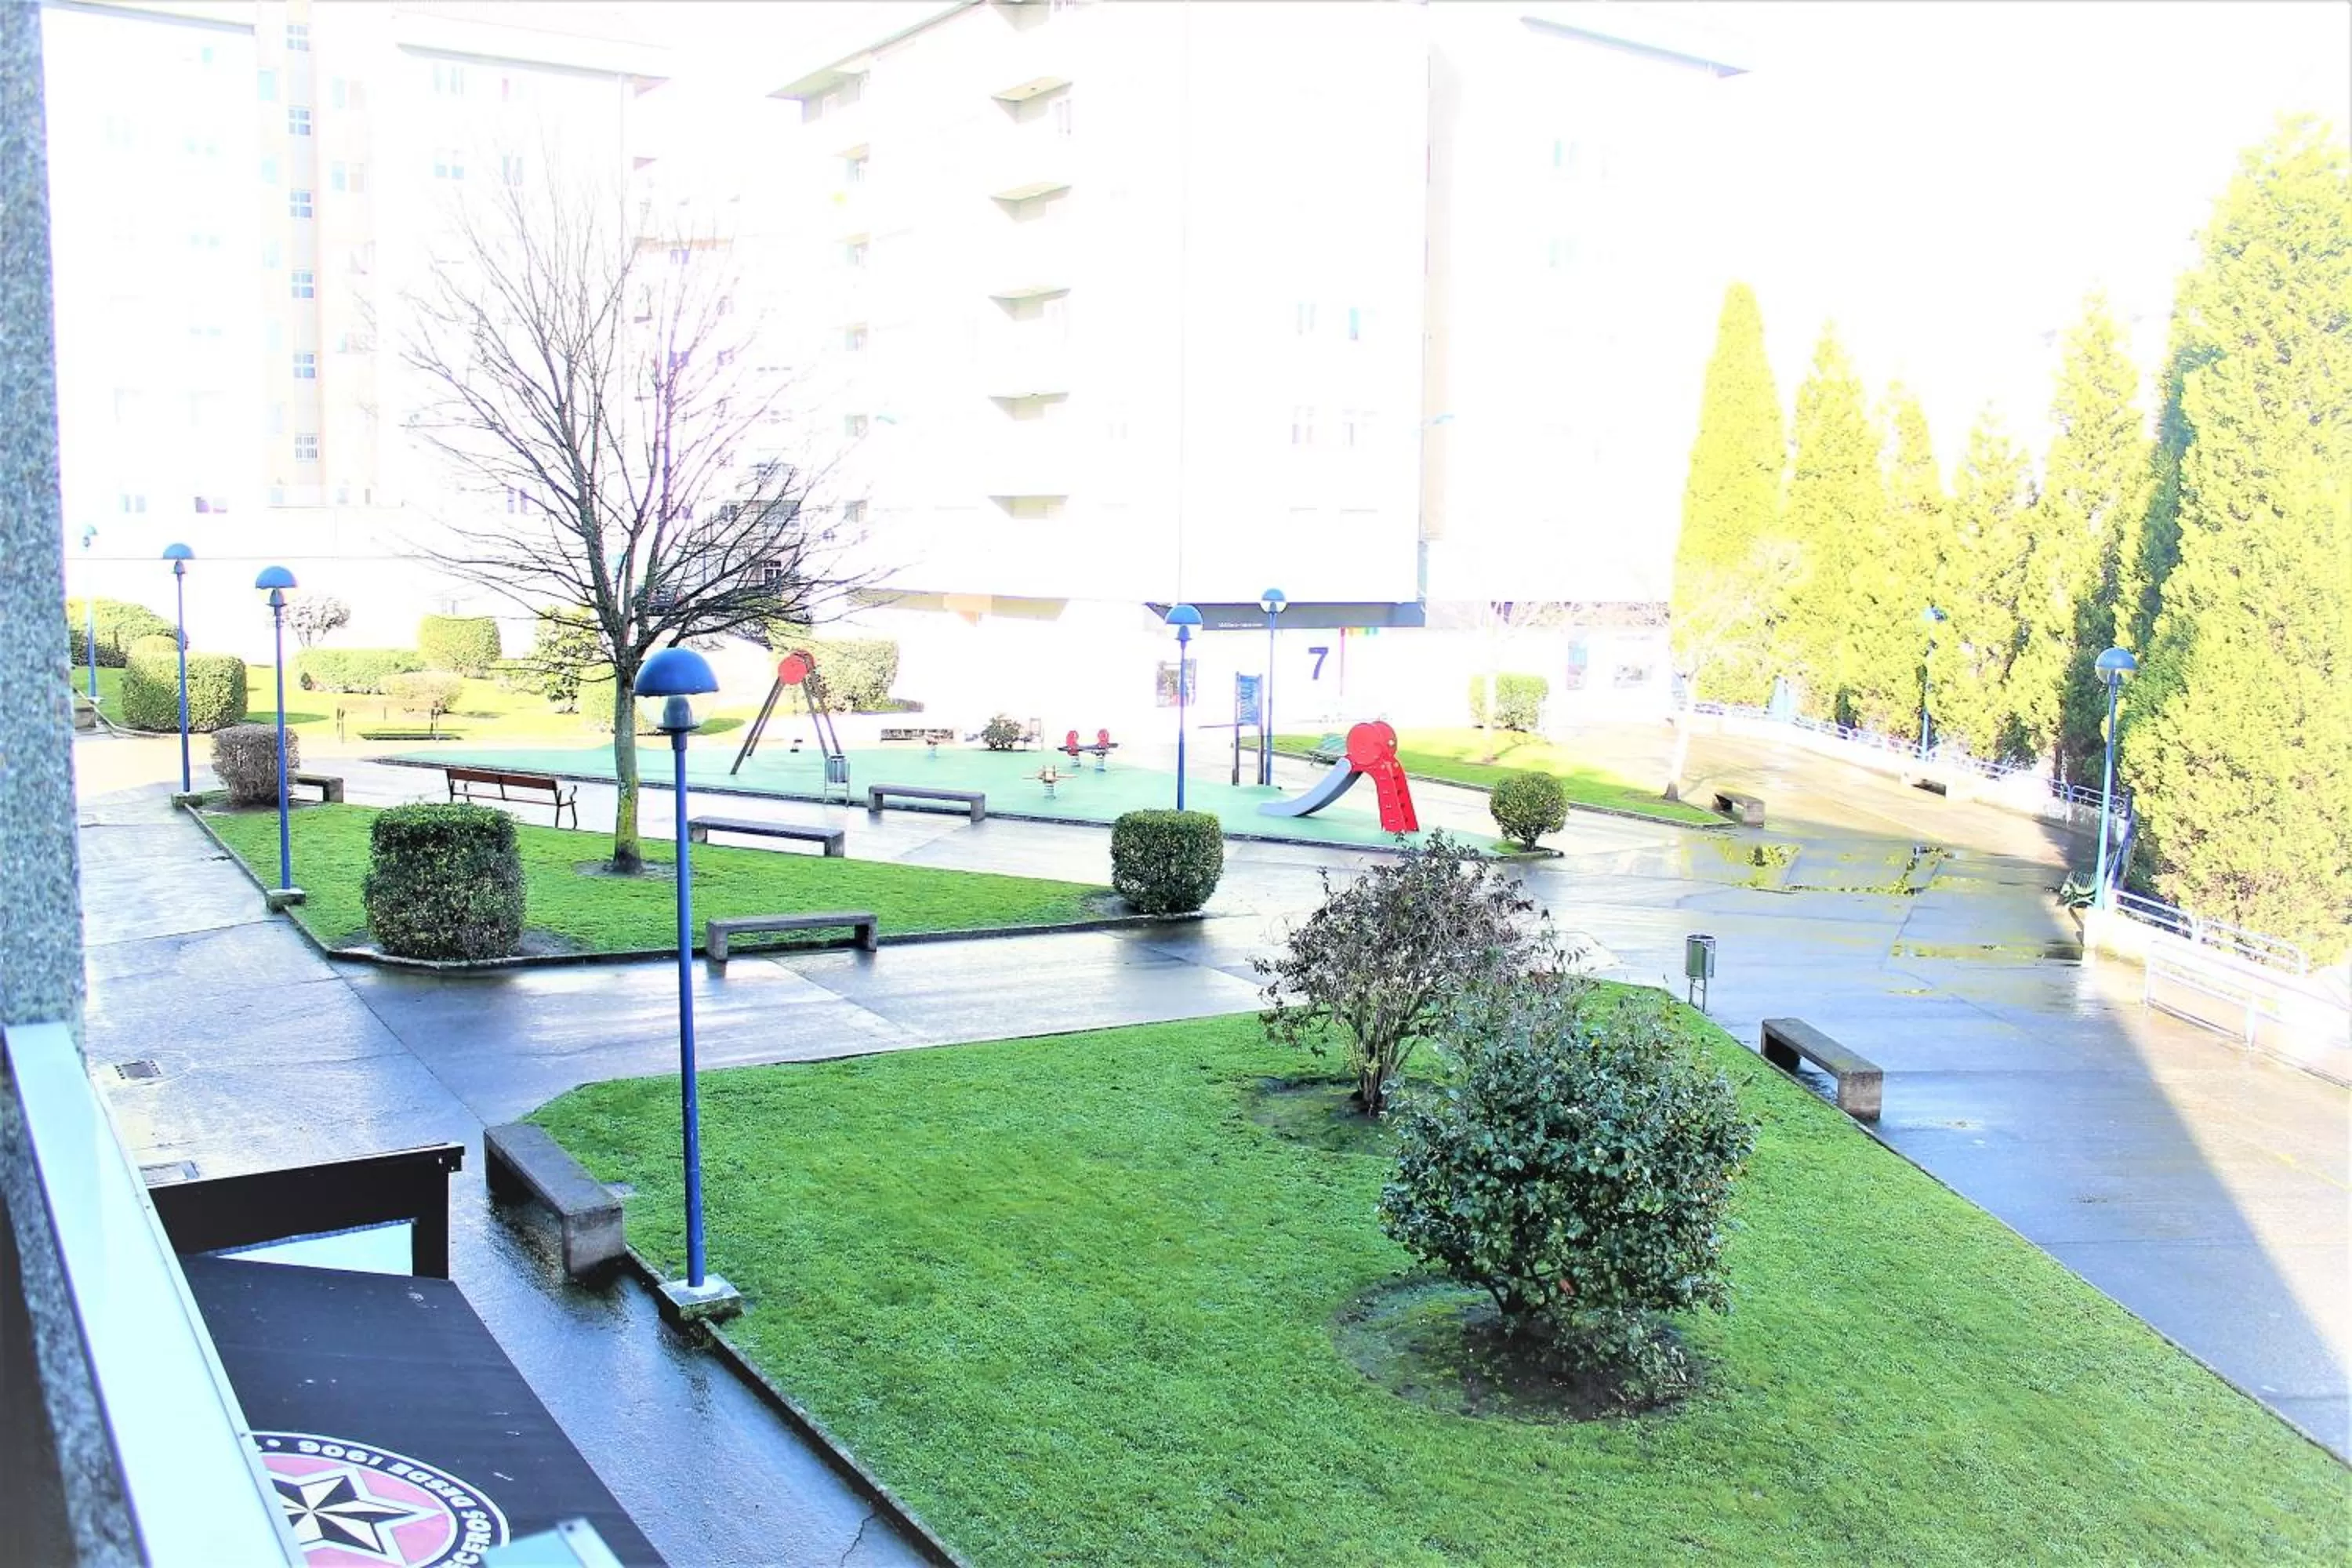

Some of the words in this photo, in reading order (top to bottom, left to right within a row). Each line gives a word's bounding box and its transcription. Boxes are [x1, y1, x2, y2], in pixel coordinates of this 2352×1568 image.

[1308, 646, 1329, 681] 7
[298, 1440, 384, 1466] 1906
[387, 1462, 477, 1508] DESDE
